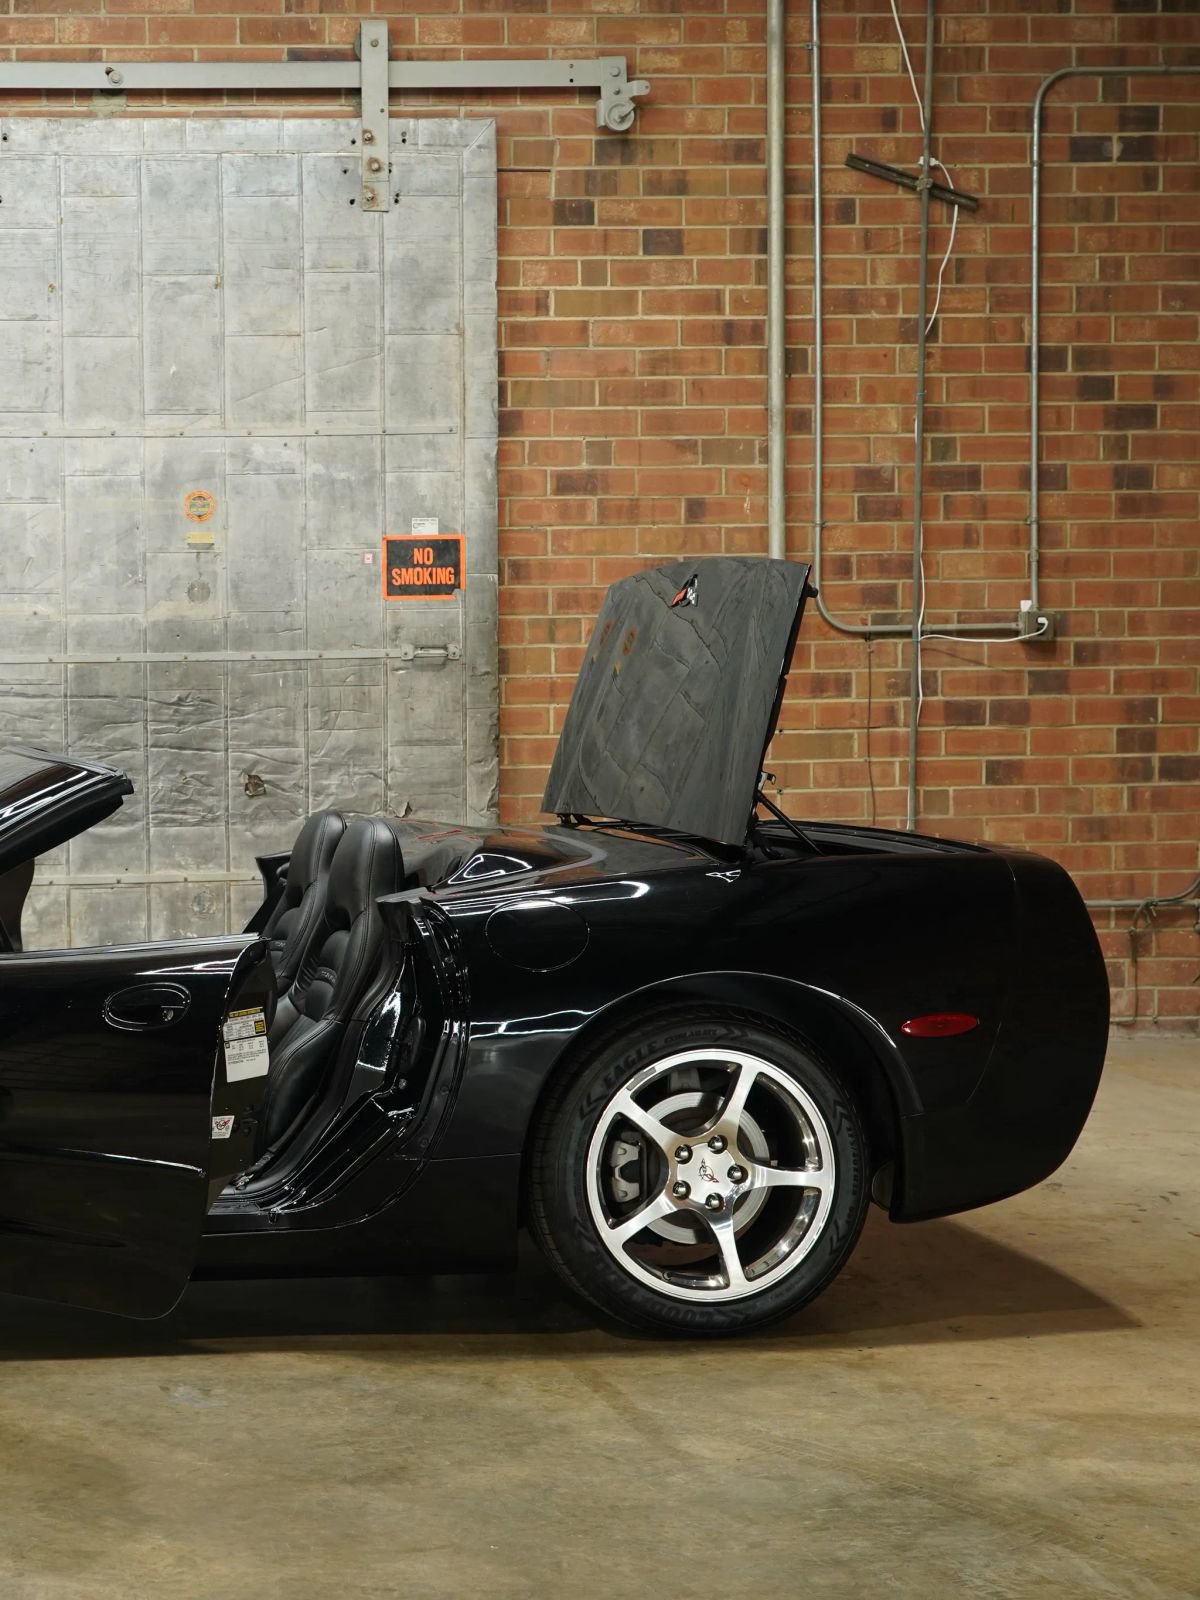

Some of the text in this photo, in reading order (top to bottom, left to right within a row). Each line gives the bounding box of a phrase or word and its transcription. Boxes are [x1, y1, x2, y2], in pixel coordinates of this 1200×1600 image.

[413, 547, 434, 565] NO
[391, 567, 455, 586] SMOKING
[603, 1038, 660, 1089] EAGLE
